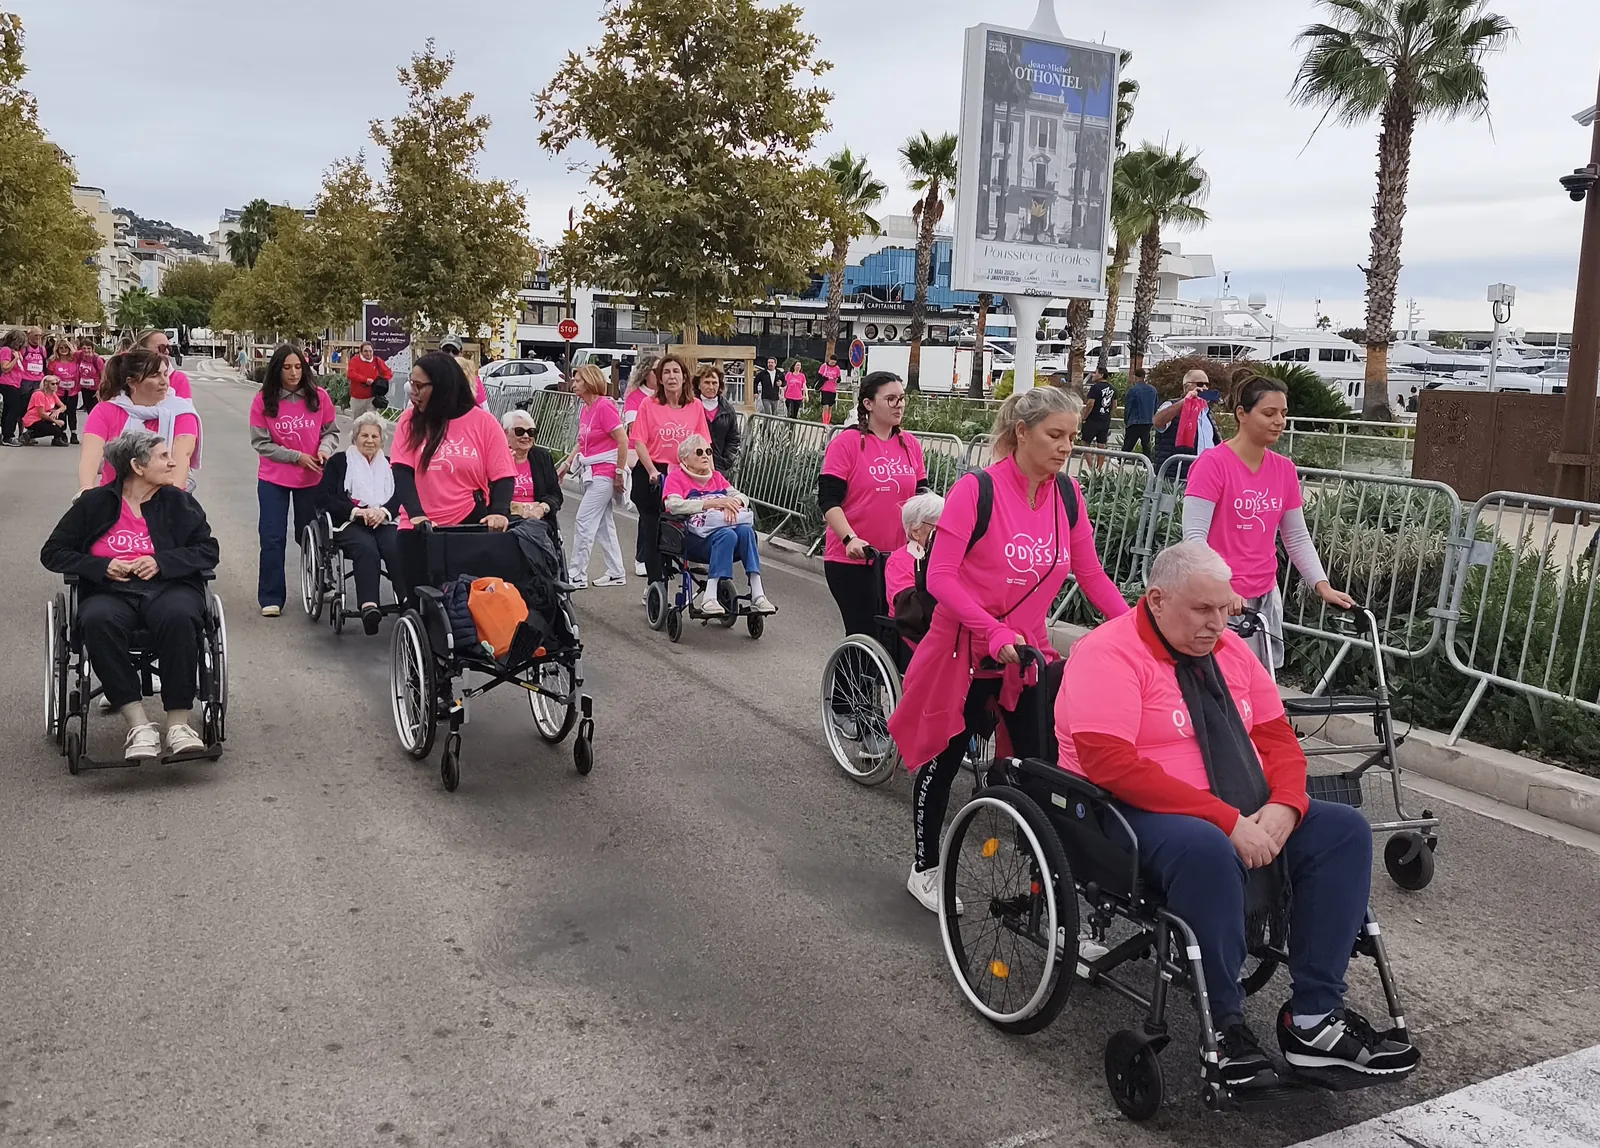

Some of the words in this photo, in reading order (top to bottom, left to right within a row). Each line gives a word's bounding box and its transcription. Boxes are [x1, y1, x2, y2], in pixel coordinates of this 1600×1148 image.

[1028, 60, 1072, 74] Jean-Michel
[1014, 66, 1083, 90] OTHONIEL
[984, 245, 1043, 262] Poussière
[867, 302, 906, 311] CAPITAINERIE
[560, 325, 578, 333] STOP
[275, 419, 316, 430] ODYSSEA
[107, 534, 154, 550] ODYSS
